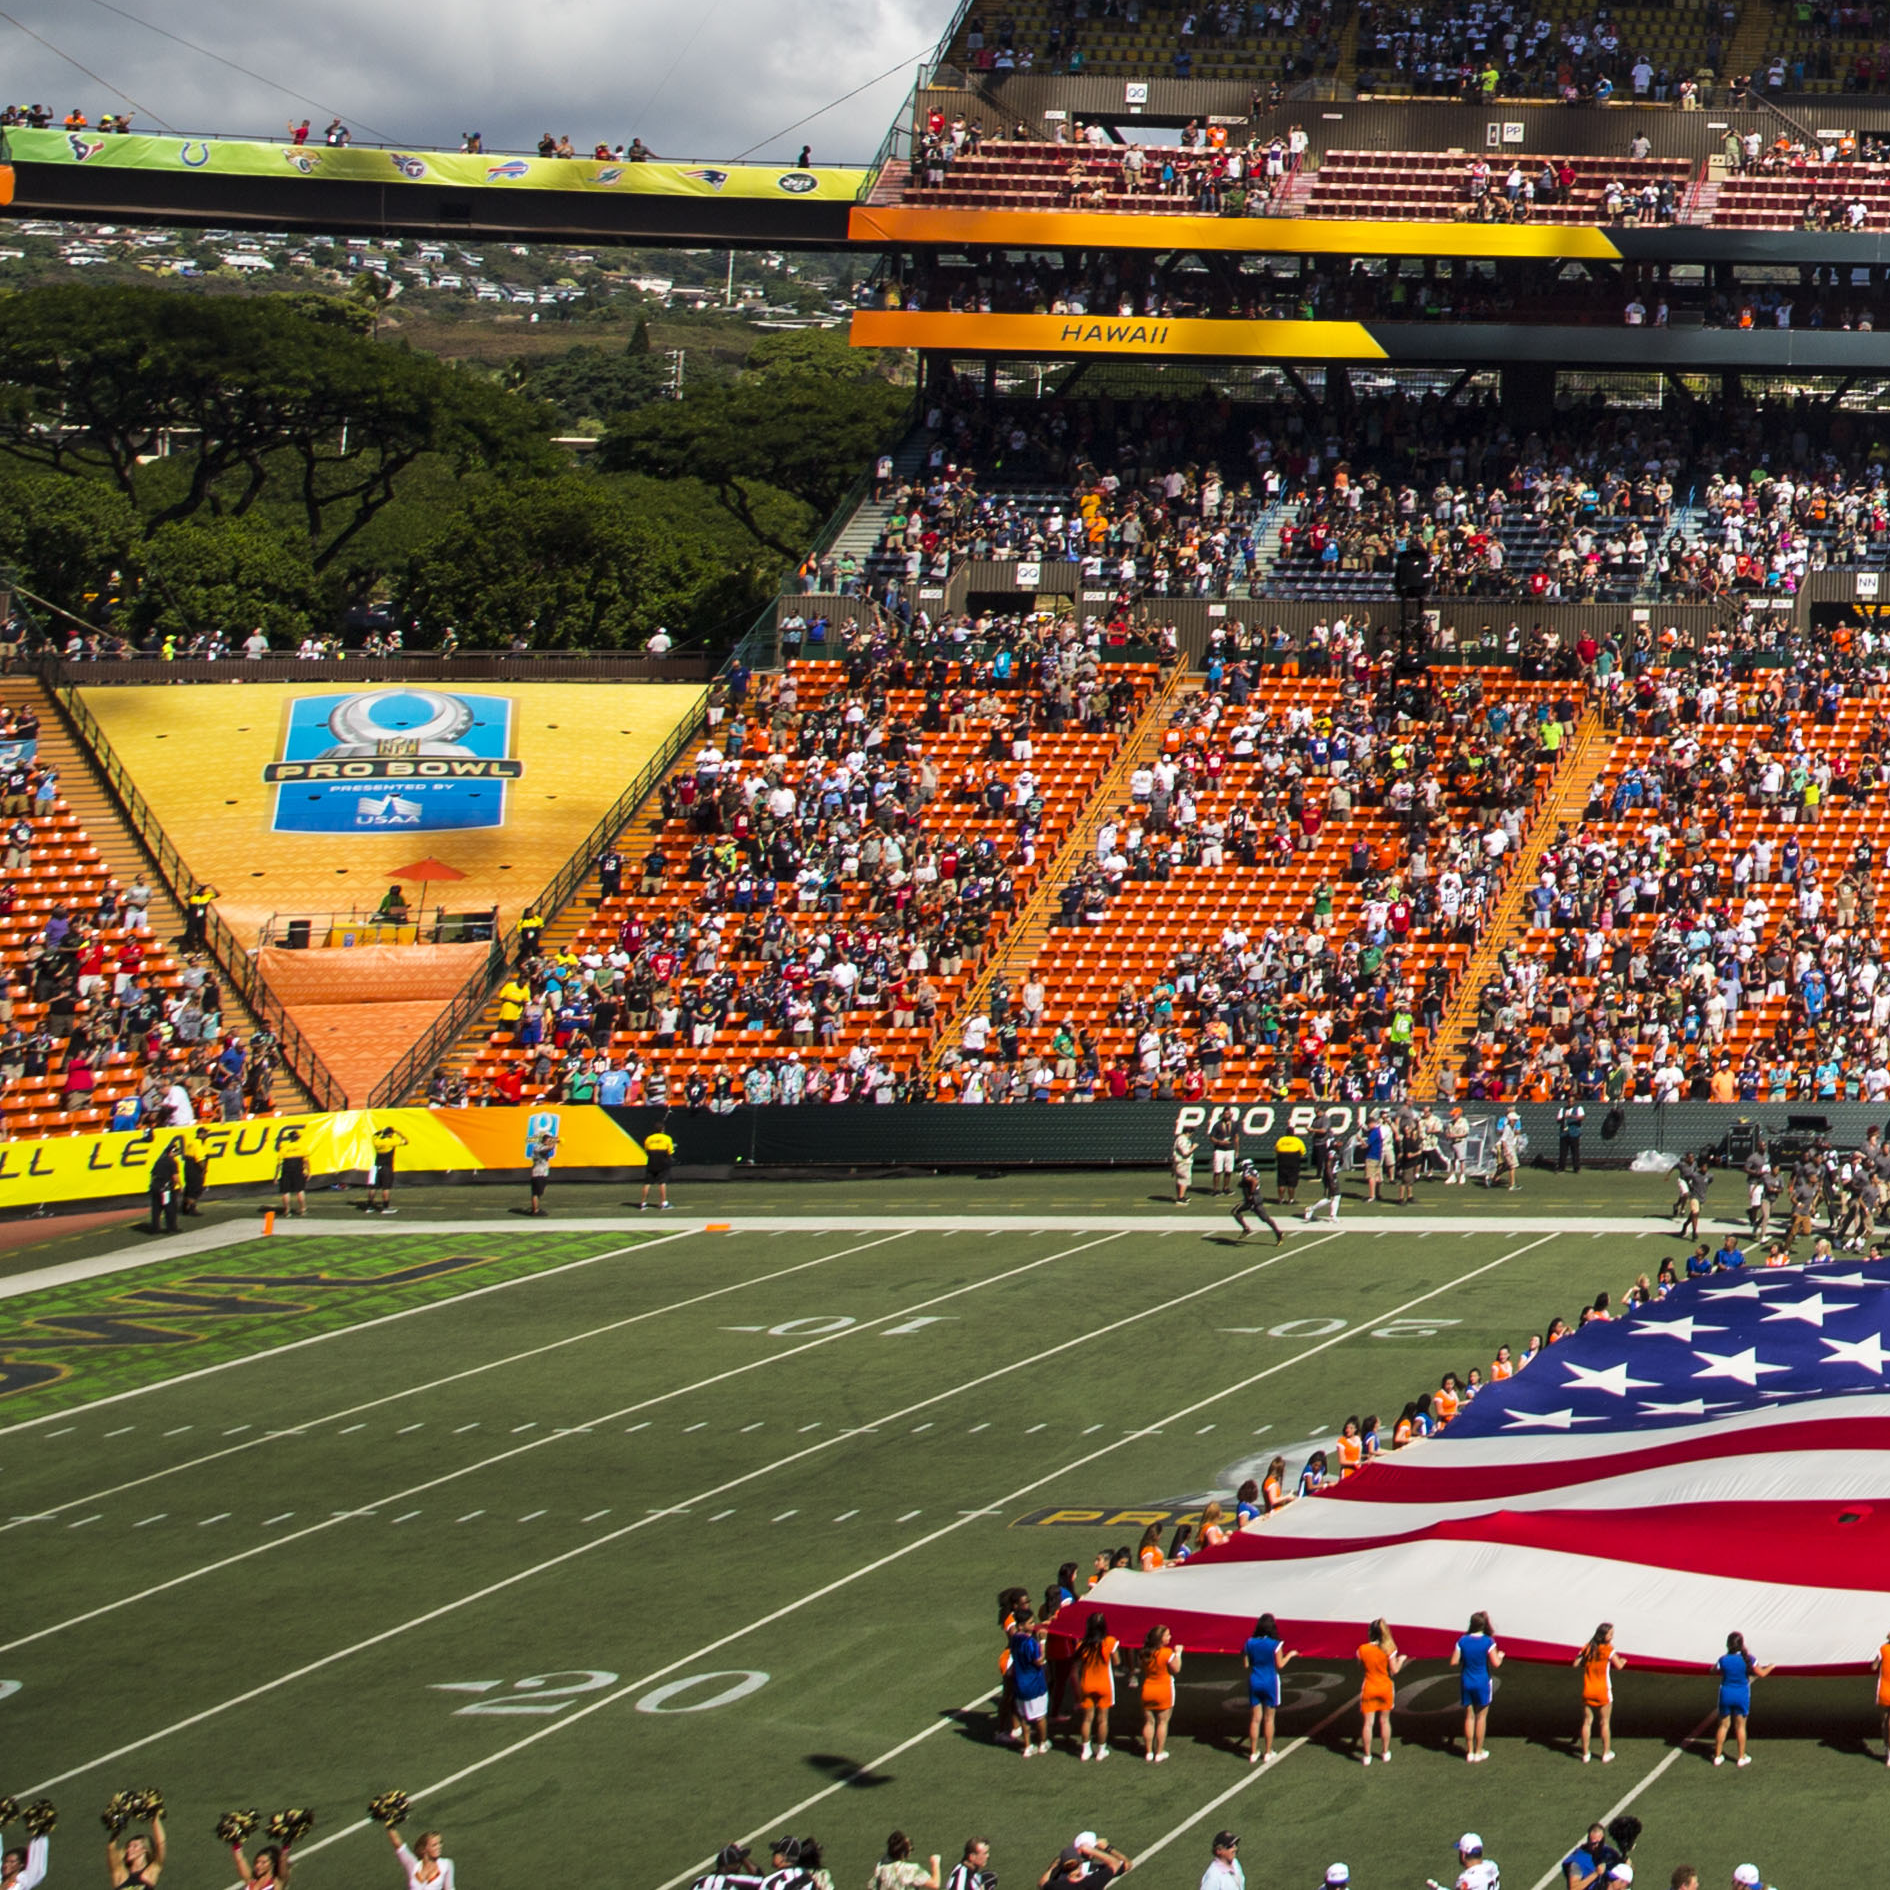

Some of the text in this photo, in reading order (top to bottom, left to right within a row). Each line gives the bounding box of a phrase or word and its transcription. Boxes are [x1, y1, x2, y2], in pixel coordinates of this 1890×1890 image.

[1506, 127, 1520, 136] PP
[1061, 325, 1170, 346] HAWAII
[1859, 577, 1877, 587] NN
[275, 761, 515, 780] PRO BOWL
[329, 783, 455, 792] PRESENTED BY
[356, 815, 421, 825] USAA
[451, 1670, 772, 1715] 20
